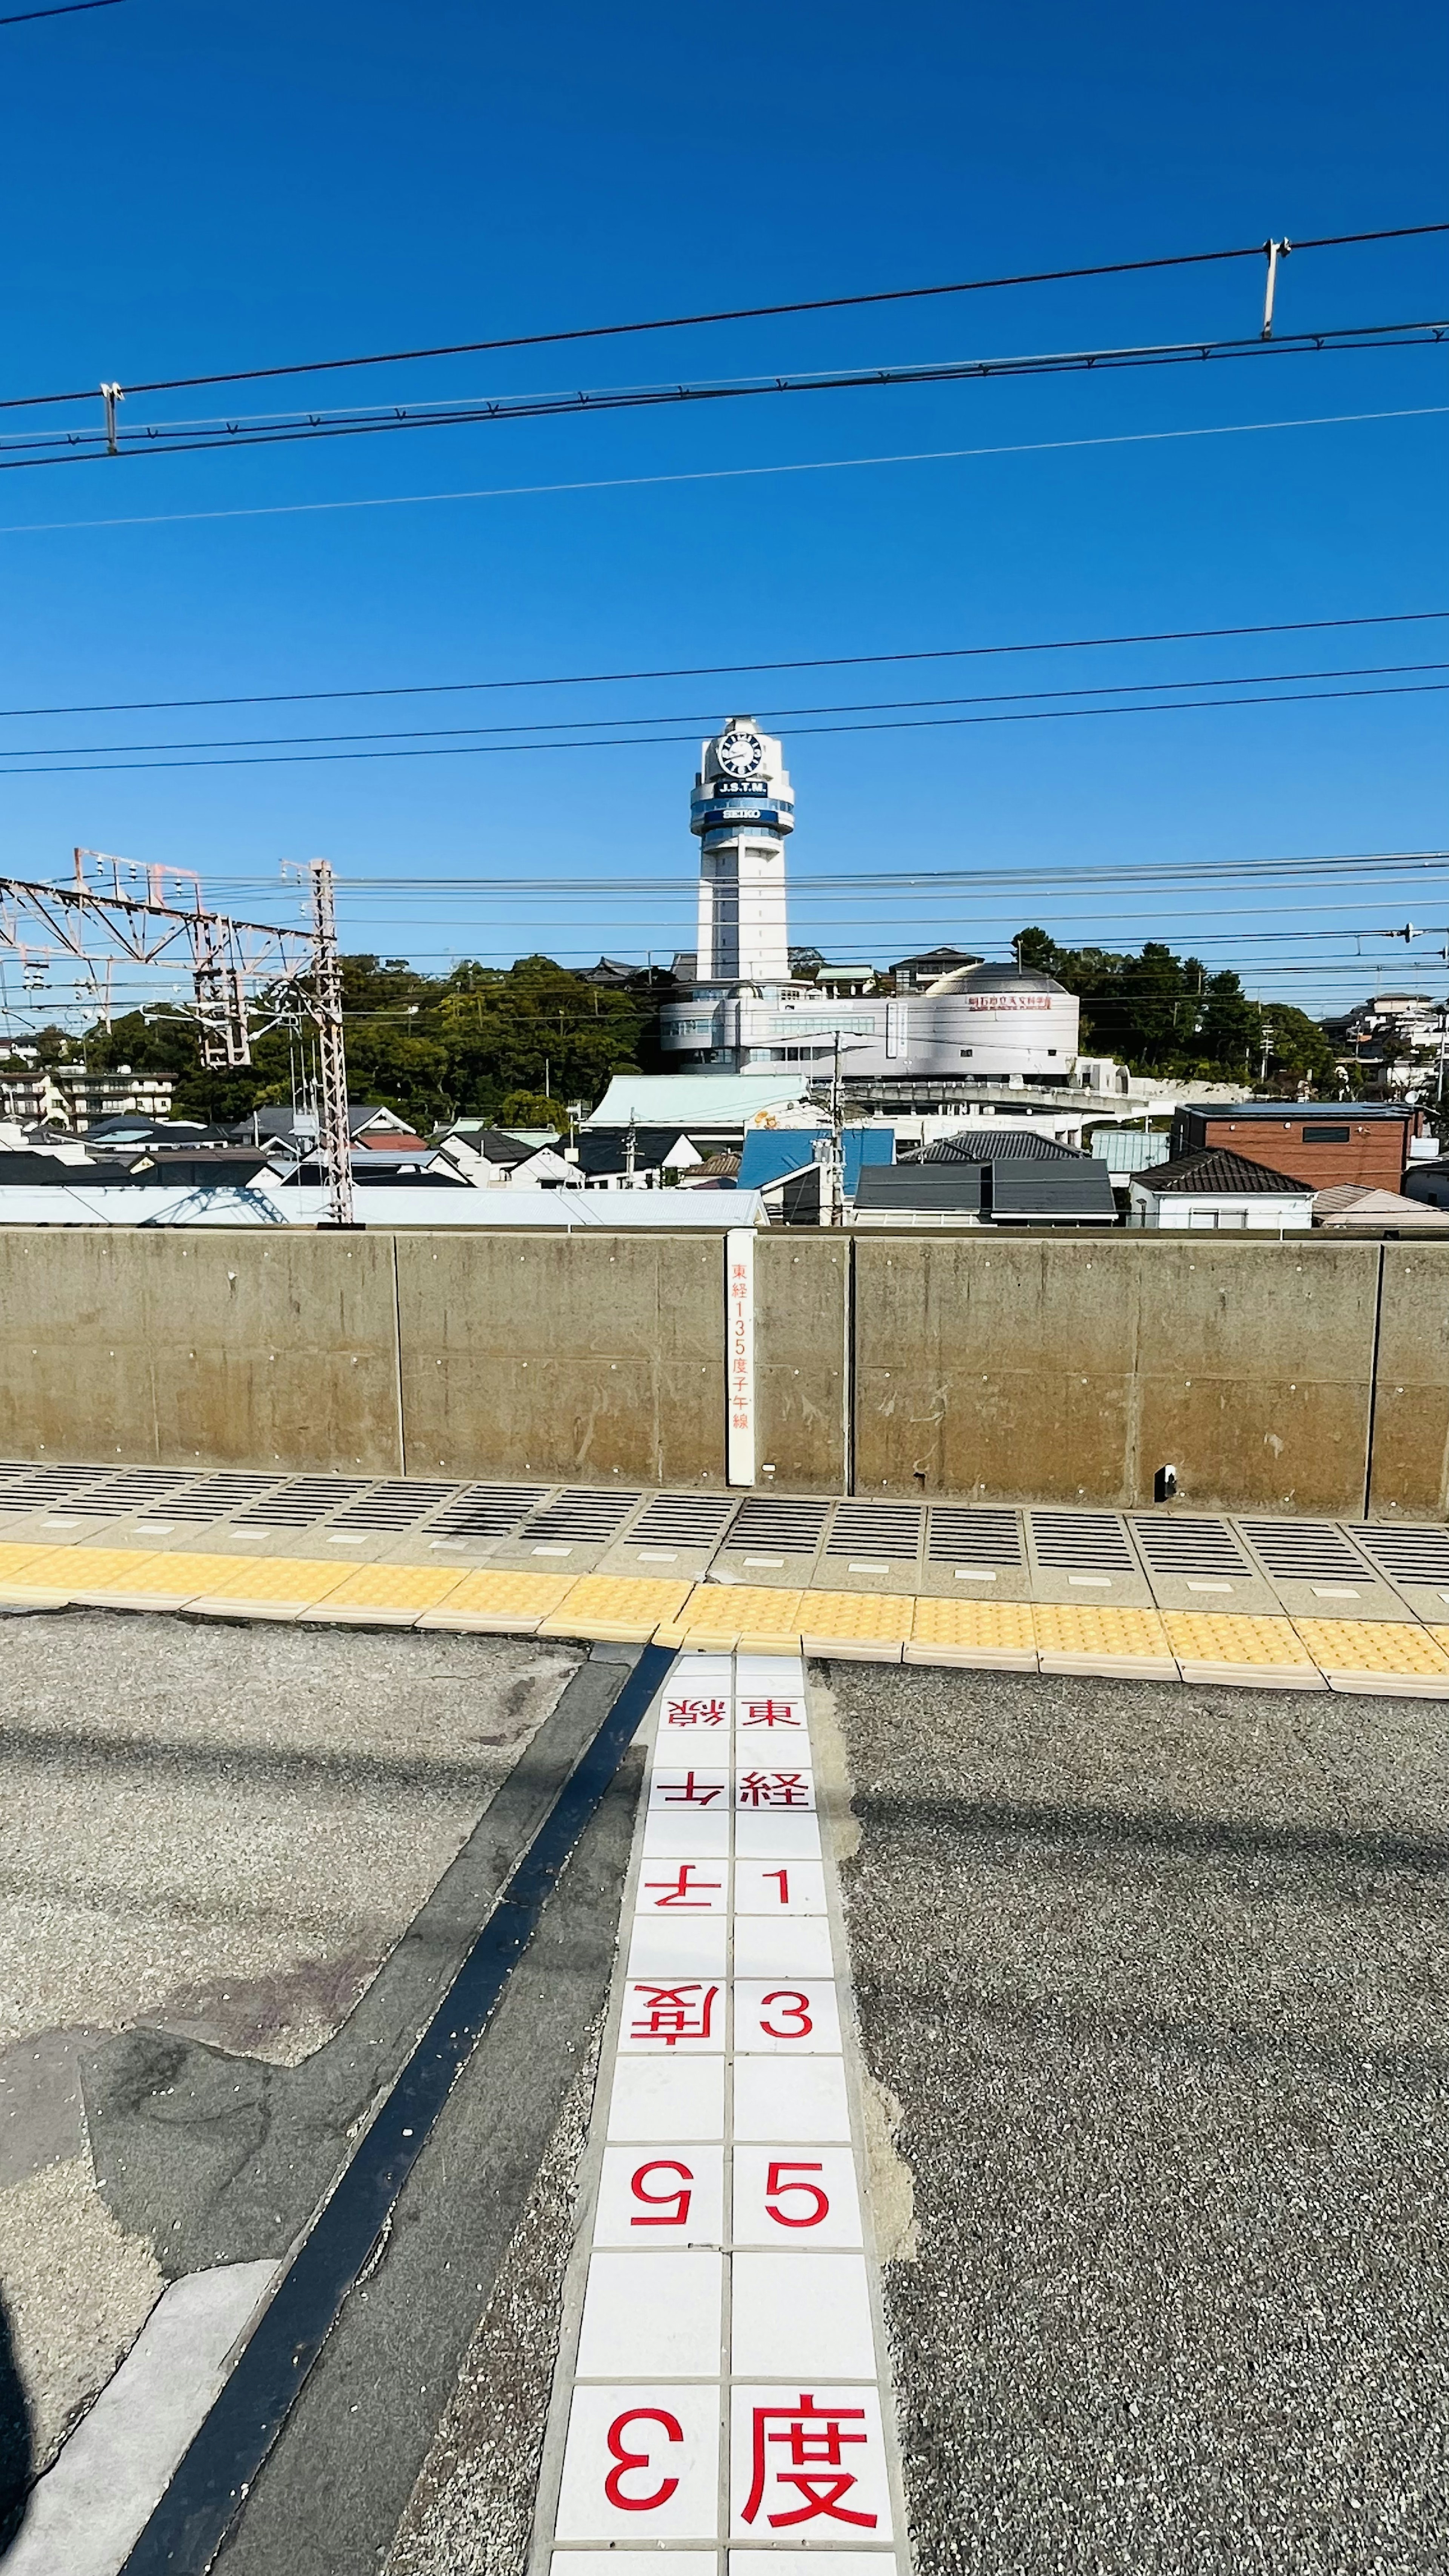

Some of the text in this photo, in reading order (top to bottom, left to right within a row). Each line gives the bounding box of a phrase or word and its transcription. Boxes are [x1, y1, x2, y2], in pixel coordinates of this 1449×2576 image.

[720, 783, 766, 792] J.S.T.M.
[723, 810, 760, 818] SEIKO
[731, 1264, 748, 1429] 東経135度子午線
